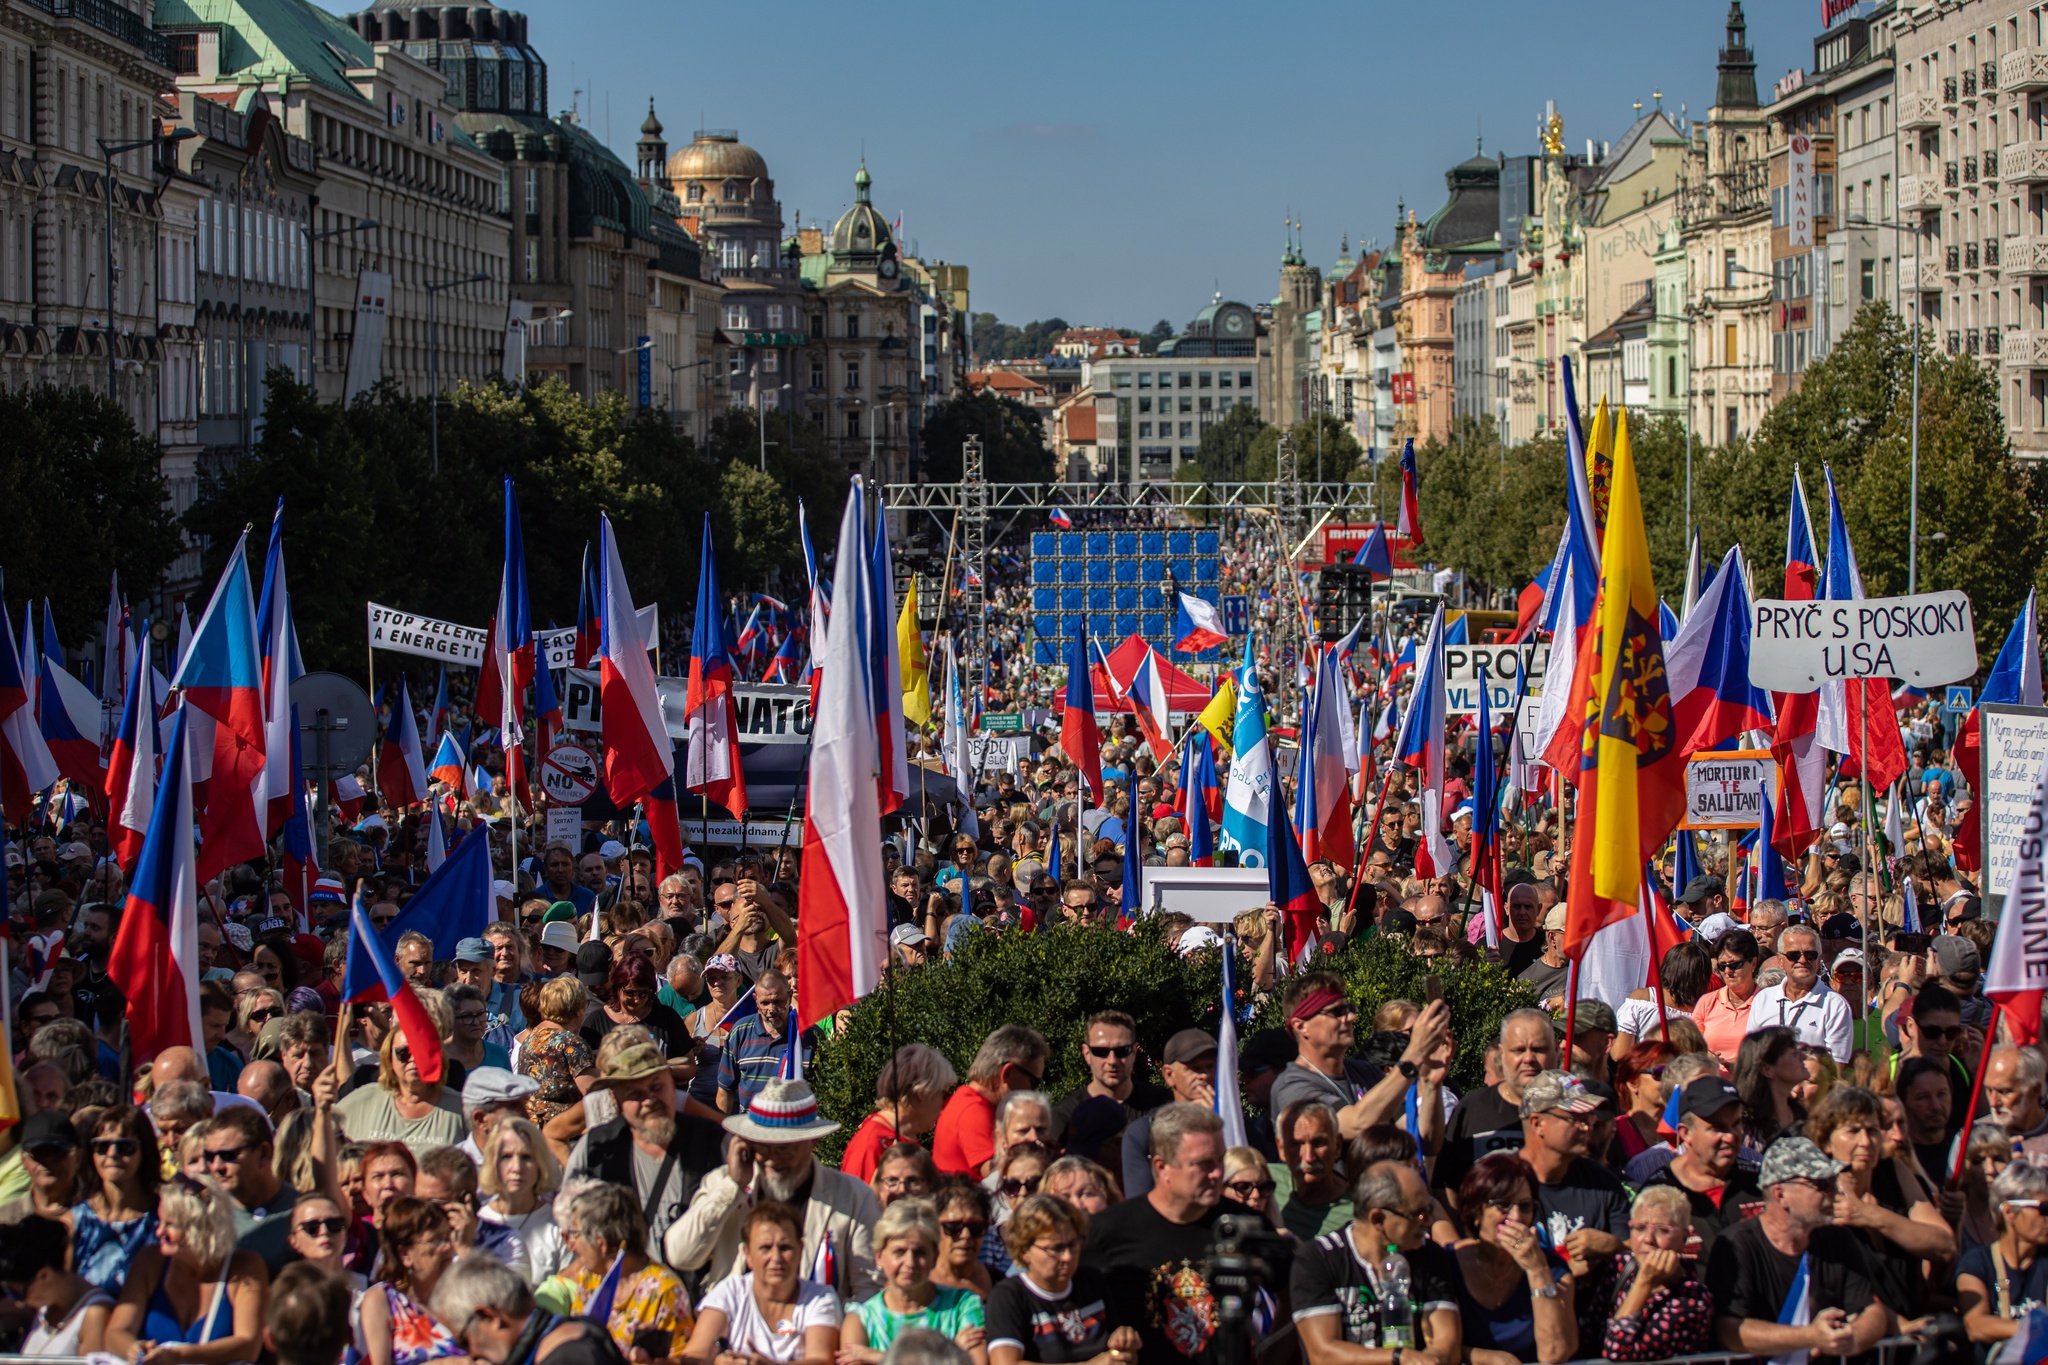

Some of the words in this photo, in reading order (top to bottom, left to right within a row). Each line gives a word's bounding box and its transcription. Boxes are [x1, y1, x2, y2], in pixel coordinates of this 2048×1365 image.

[1795, 162, 1807, 245] RAMADA
[1600, 220, 1661, 262] MERAN
[640, 341, 649, 405] OKOKO
[373, 610, 414, 626] STOP
[533, 633, 576, 650] ERO
[1756, 603, 1822, 638] PRYČ
[1832, 608, 1849, 639] S
[1859, 600, 1967, 639] POSKOKY
[374, 627, 382, 640] A
[390, 630, 486, 659] ENERGETI
[1822, 642, 1896, 676] USA
[1447, 683, 1517, 709] VLÁD
[553, 752, 590, 765] TANKS?
[2002, 739, 2029, 760] Rusko
[546, 773, 574, 789] NO
[1697, 766, 1757, 781] MORITURI
[1720, 780, 1741, 793] TE
[549, 787, 584, 799] THANKS
